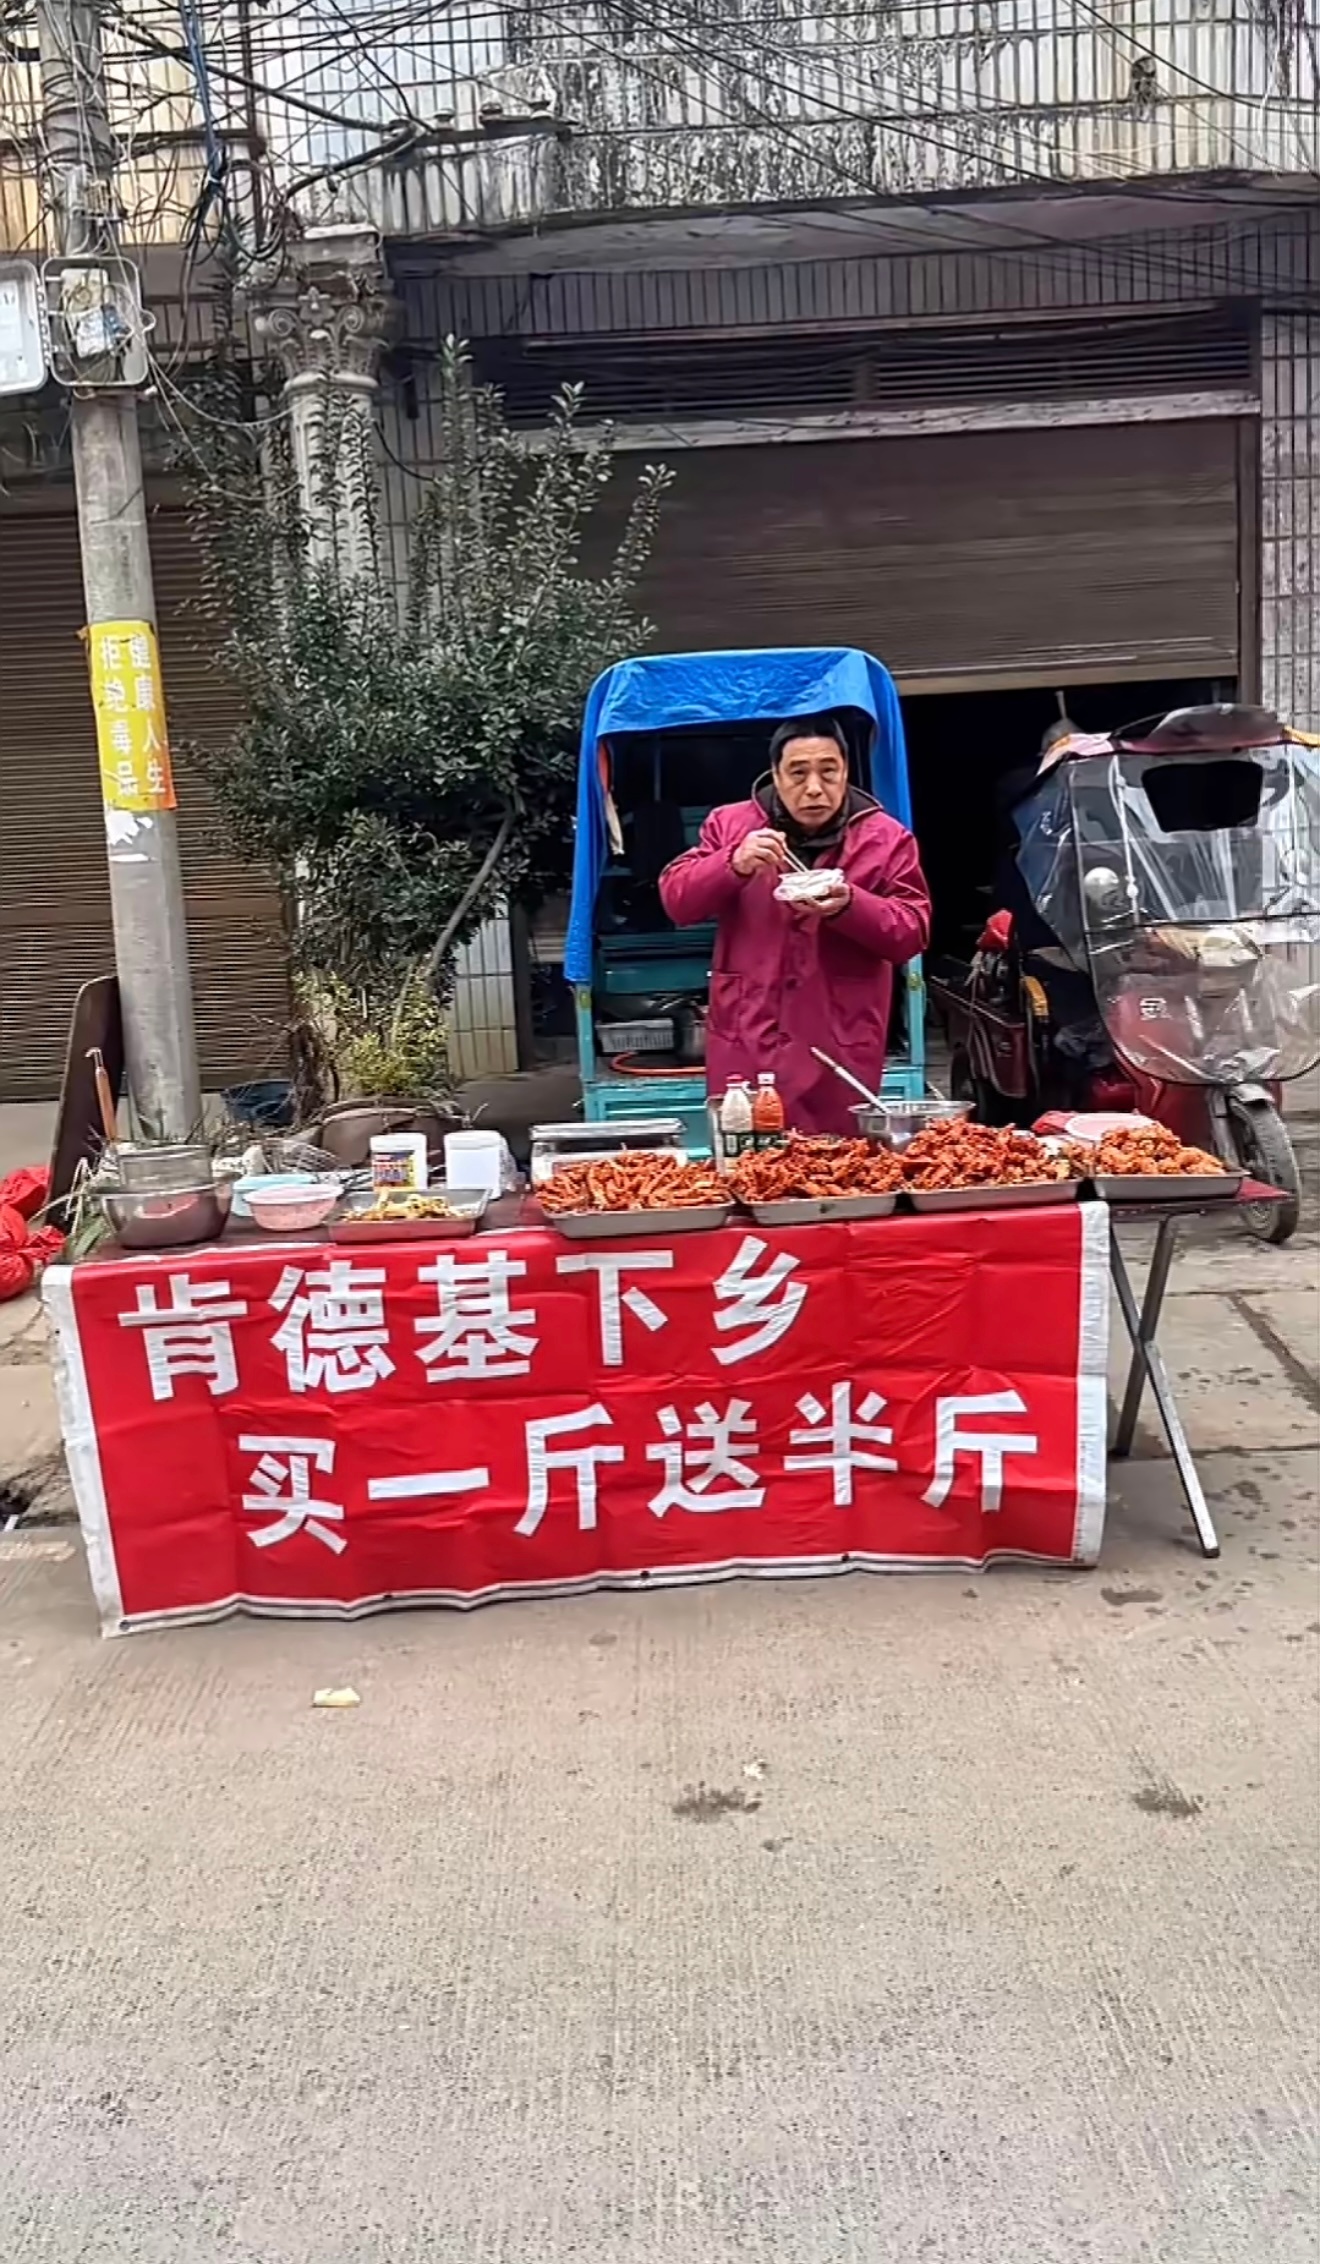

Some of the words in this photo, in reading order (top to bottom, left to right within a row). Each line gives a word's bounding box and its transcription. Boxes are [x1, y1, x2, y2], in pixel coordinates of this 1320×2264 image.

[118, 1236, 807, 1400] 肯德基下乡
[238, 1381, 1038, 1554] 买一斤送半斤
